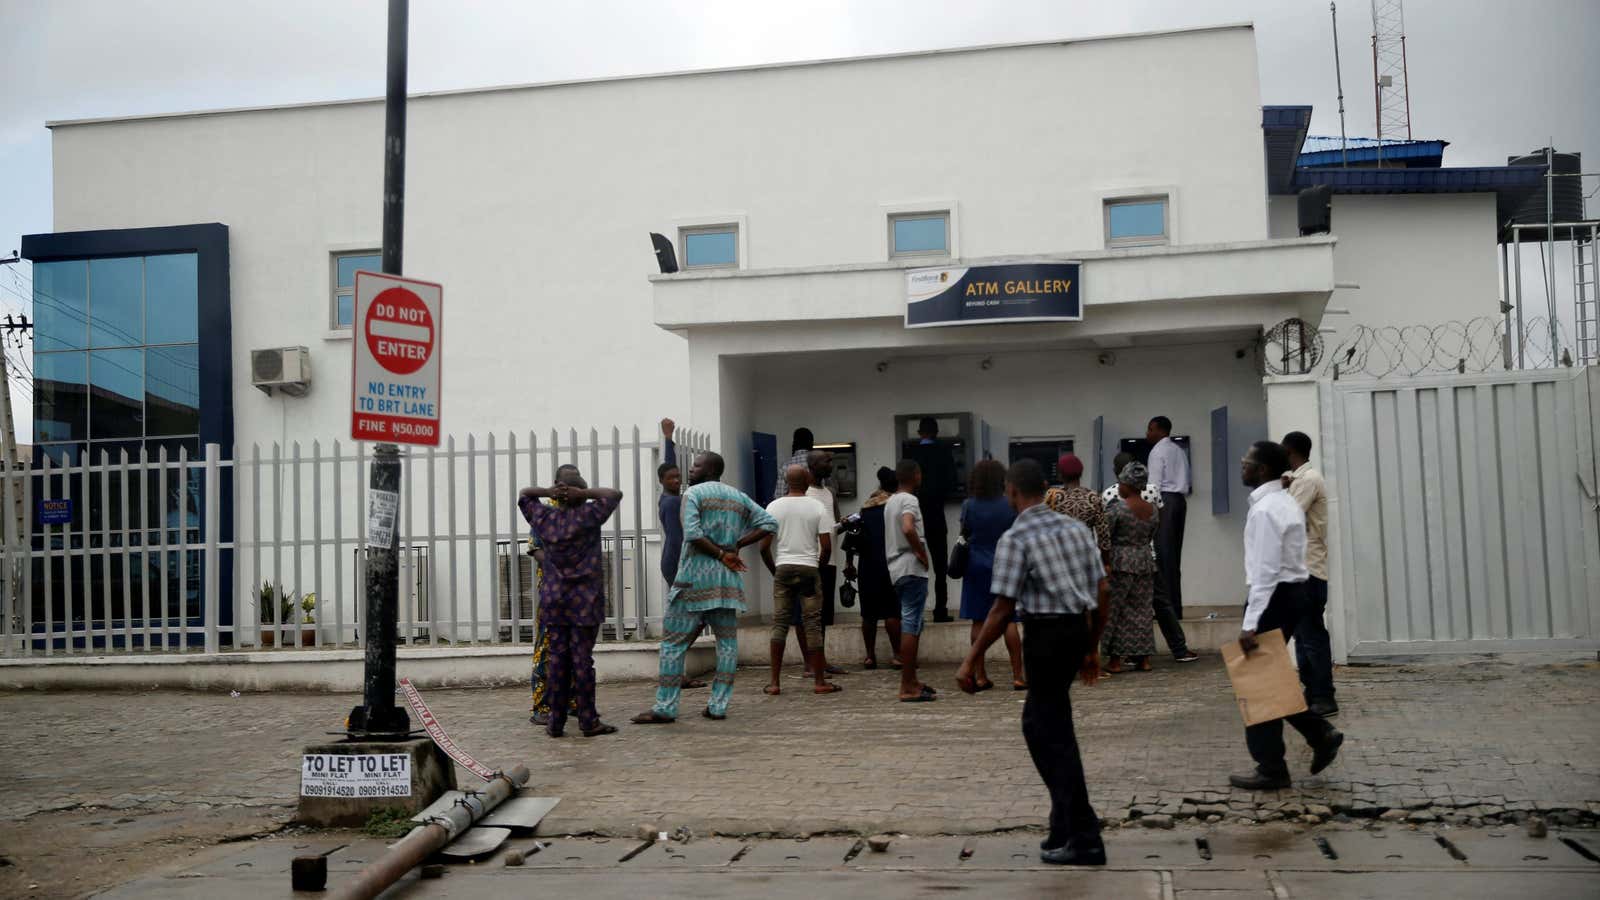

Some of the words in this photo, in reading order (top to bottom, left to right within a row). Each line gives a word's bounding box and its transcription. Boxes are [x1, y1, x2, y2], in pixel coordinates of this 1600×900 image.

[966, 282, 999, 296] ATM
[1004, 280, 1072, 295] GALLERY
[376, 303, 394, 318] DO
[399, 308, 426, 322] NOT
[377, 341, 427, 360] ENTER
[368, 382, 385, 395] NO
[389, 384, 427, 400] ENTRY
[359, 397, 374, 411] TO
[378, 400, 400, 414] BRT
[404, 402, 434, 416] LANE
[359, 419, 386, 433] FINE
[404, 685, 432, 724] MURTALA
[428, 724, 474, 765] MUHAMMED
[306, 756, 324, 772] TO
[329, 756, 355, 773] LET
[358, 756, 376, 772] TO
[382, 755, 407, 772] LET
[305, 785, 355, 796] 09091914520
[359, 785, 409, 796] 09091914520
